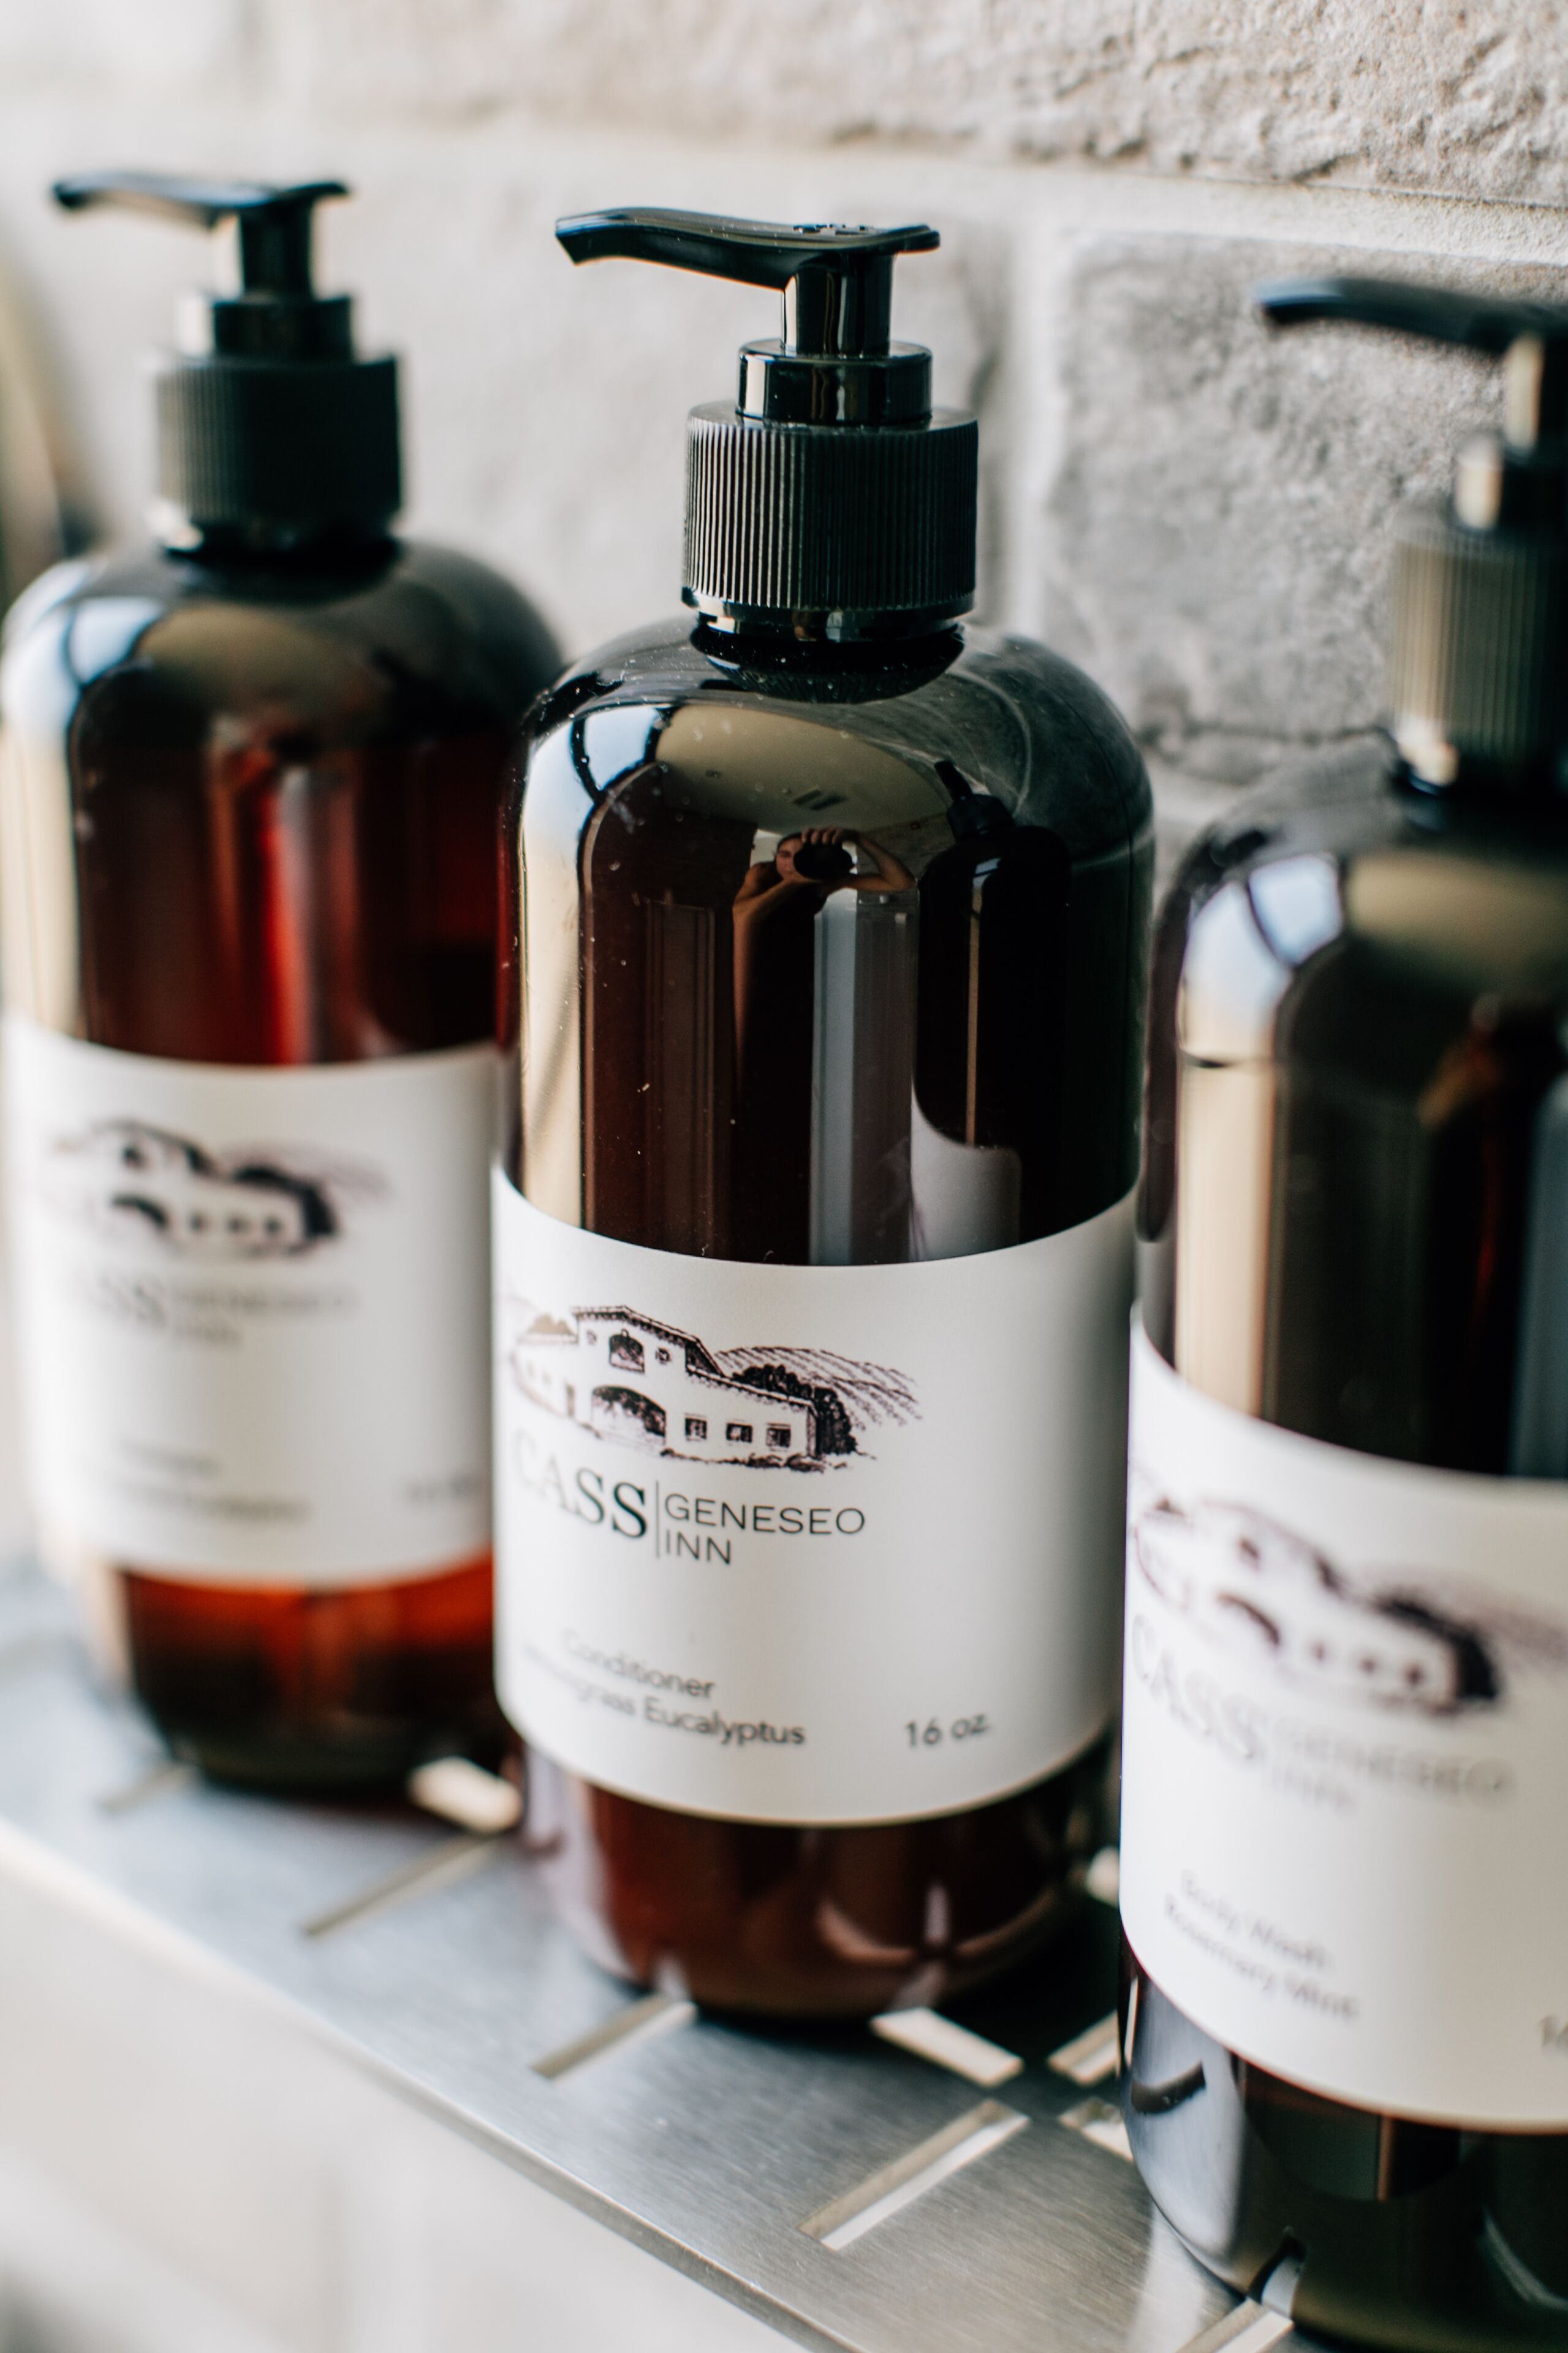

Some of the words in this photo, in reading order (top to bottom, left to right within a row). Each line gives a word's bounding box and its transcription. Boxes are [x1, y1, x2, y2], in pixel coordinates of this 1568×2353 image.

[513, 1427, 649, 1540] CASS
[664, 1492, 867, 1536] GENESEO
[665, 1528, 733, 1566] INN
[560, 1627, 718, 1702] Conditioner
[643, 1695, 807, 1749] Eucalyptus
[903, 1717, 944, 1751] 16
[949, 1711, 995, 1743] oz
